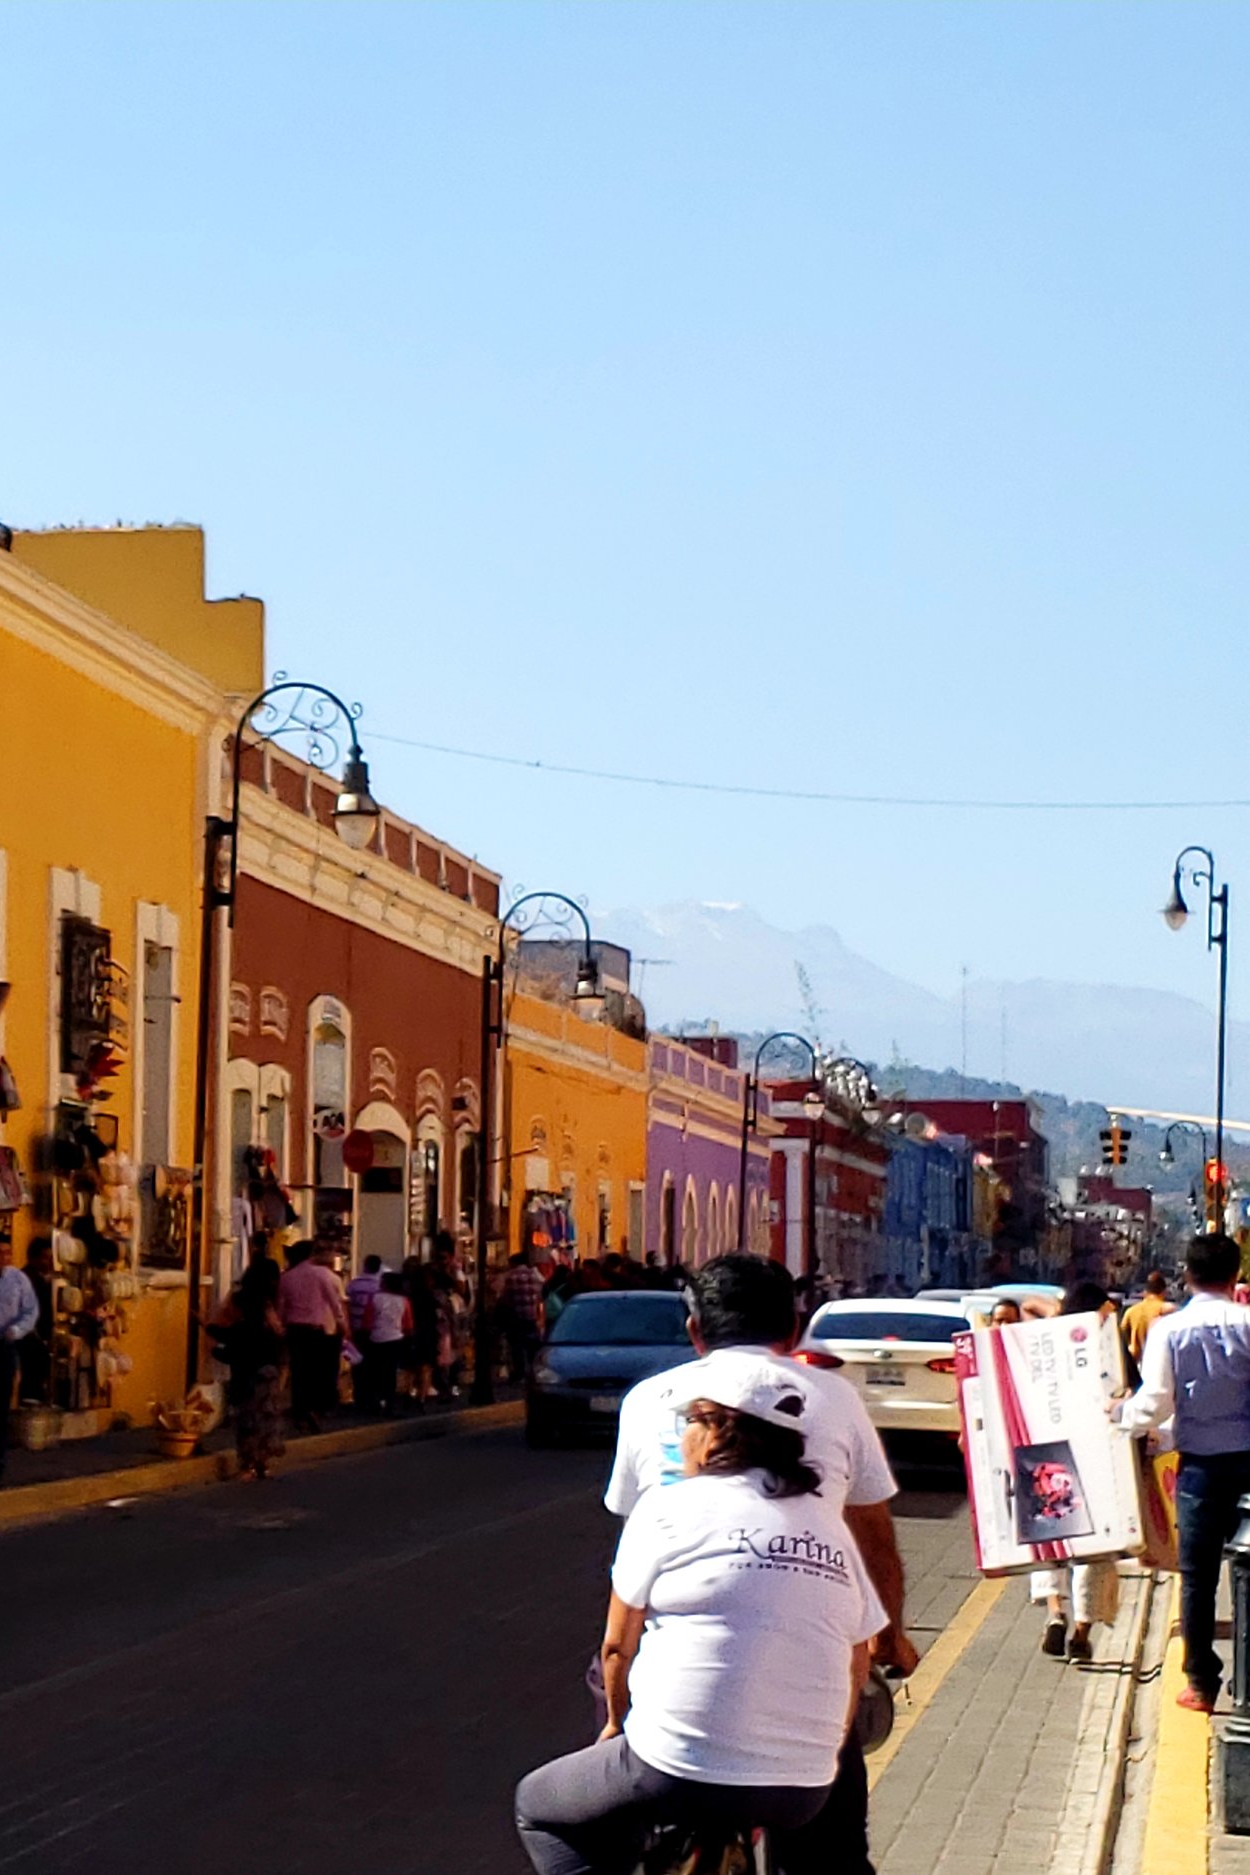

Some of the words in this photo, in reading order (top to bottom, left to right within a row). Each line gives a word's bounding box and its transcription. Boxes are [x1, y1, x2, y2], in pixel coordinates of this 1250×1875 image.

[1030, 1341, 1041, 1357] TV
[1041, 1331, 1054, 1356] LED
[1043, 1357, 1057, 1373] TV
[1075, 1347, 1088, 1368] LG
[1030, 1358, 1043, 1384] DEL
[1047, 1381, 1060, 1397] TV
[1048, 1398, 1062, 1425] LED
[728, 1527, 847, 1570] Karina
